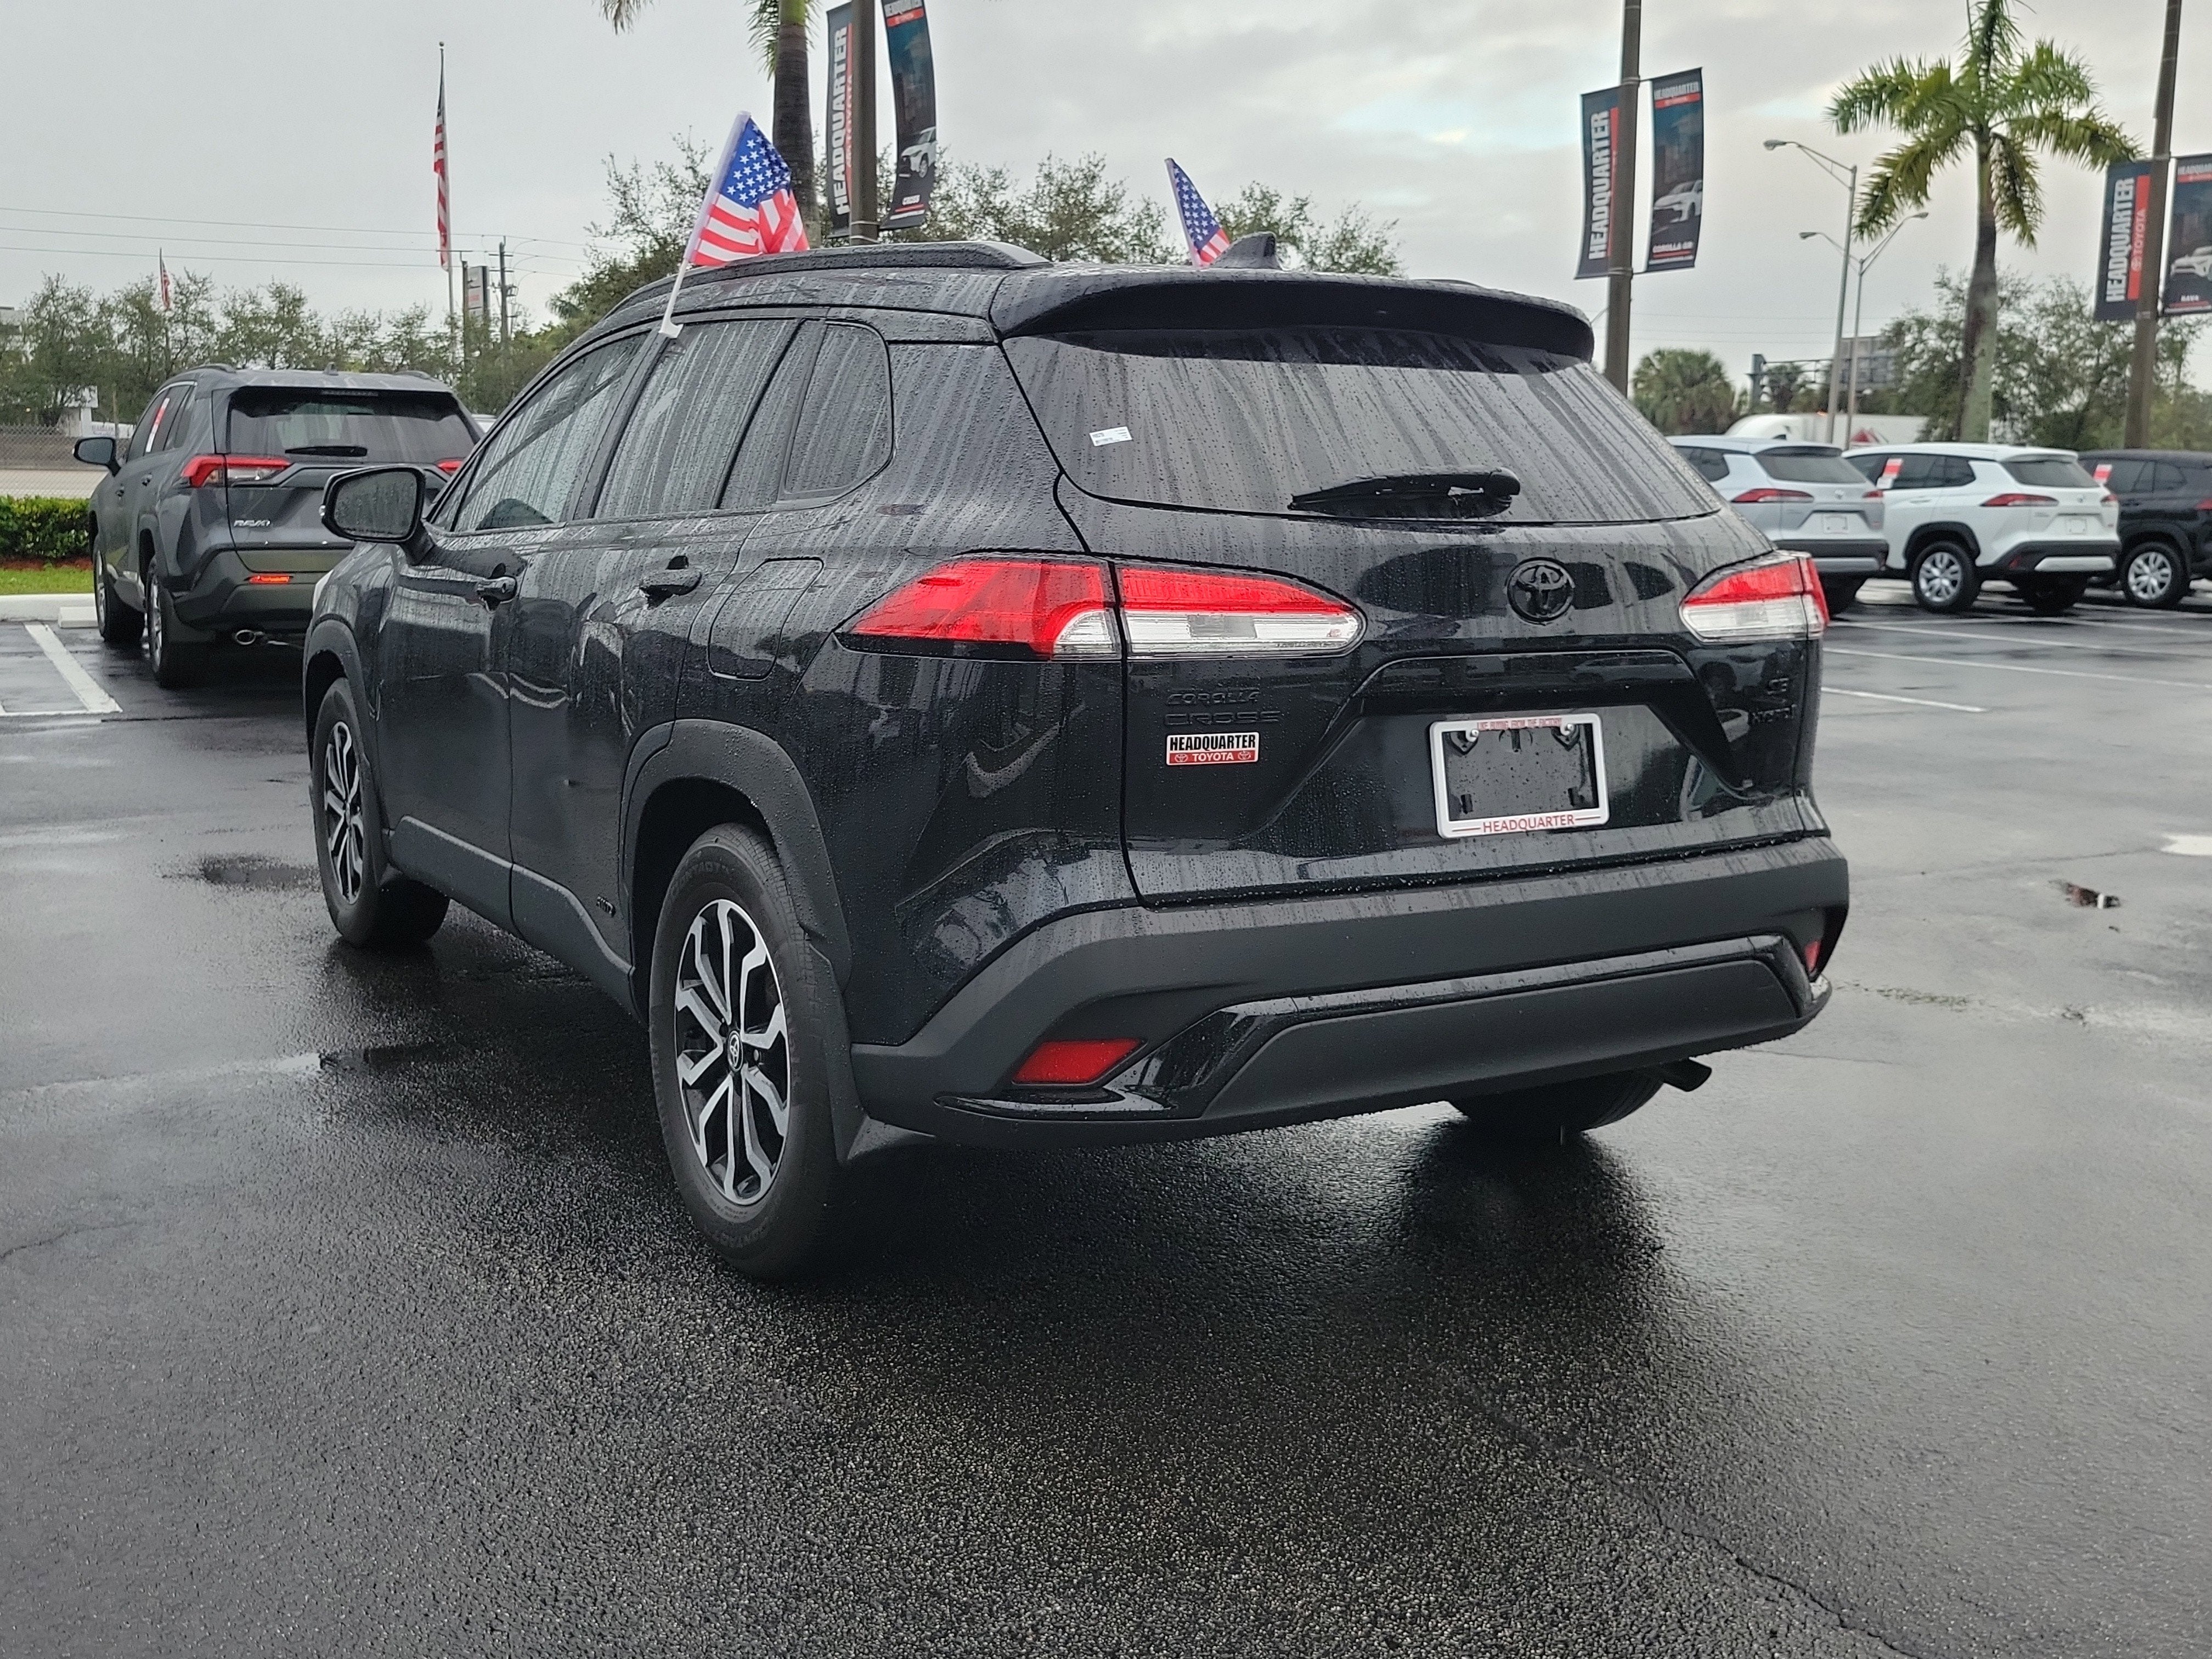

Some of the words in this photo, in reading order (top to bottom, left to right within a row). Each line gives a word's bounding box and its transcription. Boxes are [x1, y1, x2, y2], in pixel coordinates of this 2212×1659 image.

[832, 27, 850, 215] HEADQUARTER
[1589, 110, 1610, 259] HEADQUARTER
[2106, 177, 2135, 302] HEADQUARTER
[1167, 691, 1260, 705] COROLLA
[1165, 711, 1281, 725] CROSS
[1170, 735, 1256, 751] HEADQUARTER
[1192, 752, 1234, 762] TOYOTA
[1483, 814, 1575, 833] HEADQUARTER
